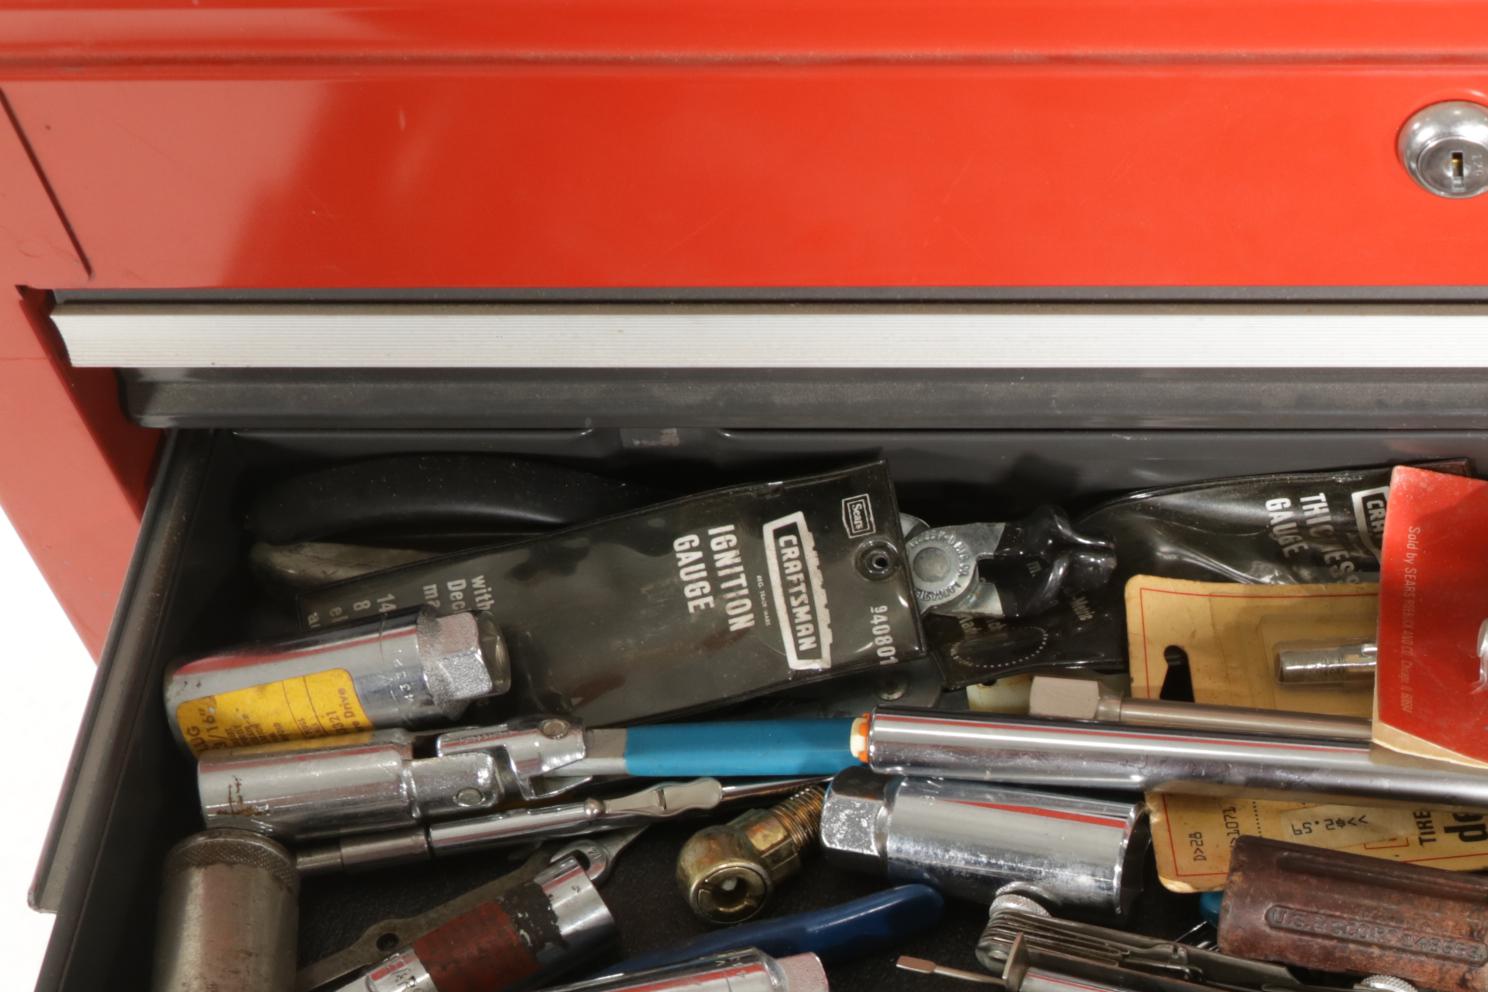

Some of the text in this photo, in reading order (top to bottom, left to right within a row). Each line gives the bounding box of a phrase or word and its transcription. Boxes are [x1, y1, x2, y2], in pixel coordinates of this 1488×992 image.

[851, 502, 864, 531] Sears
[1265, 497, 1309, 558] GAUGE
[1405, 525, 1421, 550] Sold
[672, 533, 715, 614] GAUGE
[1403, 551, 1419, 565] by
[707, 524, 756, 632] IGNITION
[778, 533, 818, 652] CRAFTSMAN
[337, 687, 354, 719] Drive
[1412, 811, 1437, 846] TIRE
